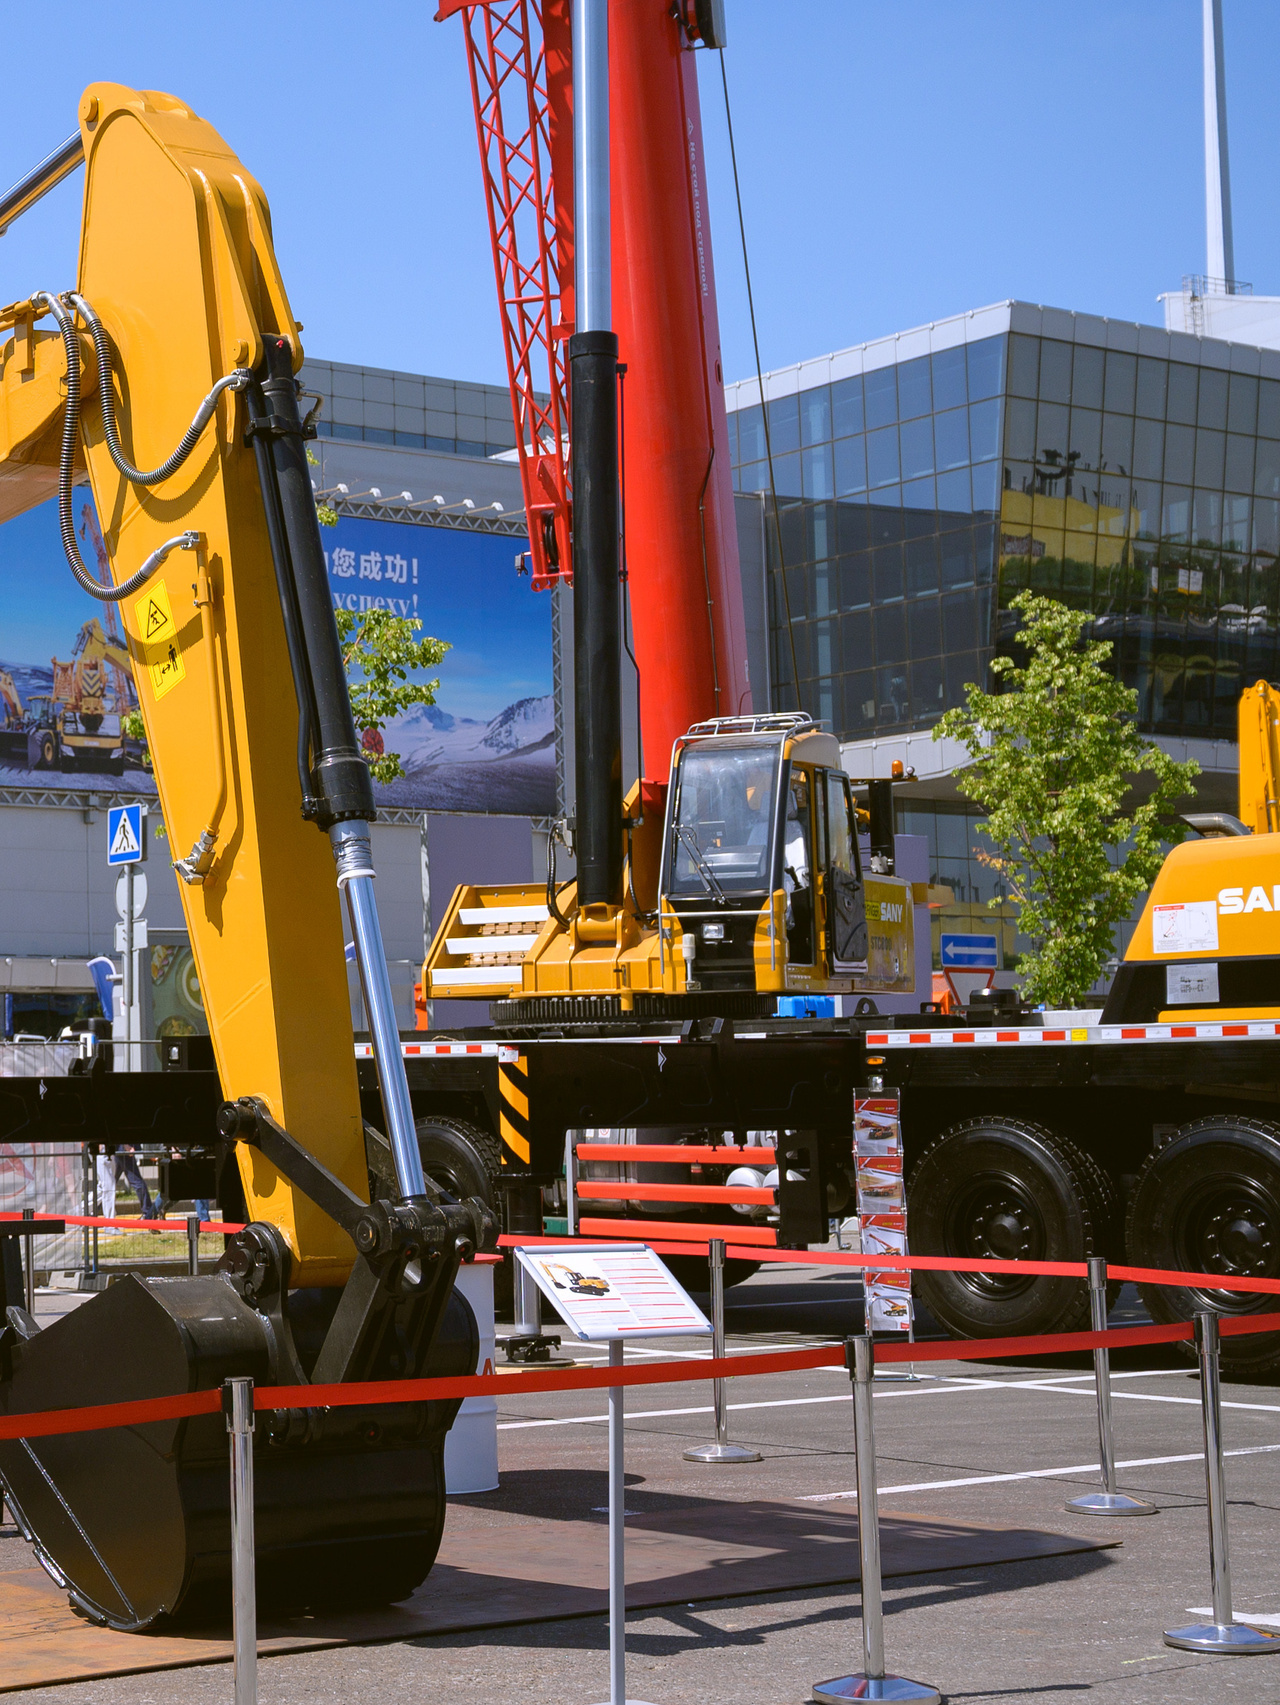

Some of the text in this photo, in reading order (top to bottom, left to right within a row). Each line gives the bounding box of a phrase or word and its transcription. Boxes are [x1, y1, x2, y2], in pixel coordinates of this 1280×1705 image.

[690, 163, 700, 198] стой
[694, 201, 702, 228] под
[324, 547, 419, 585] 您成功!
[880, 902, 903, 923] SANY
[1218, 884, 1280, 915] SA
